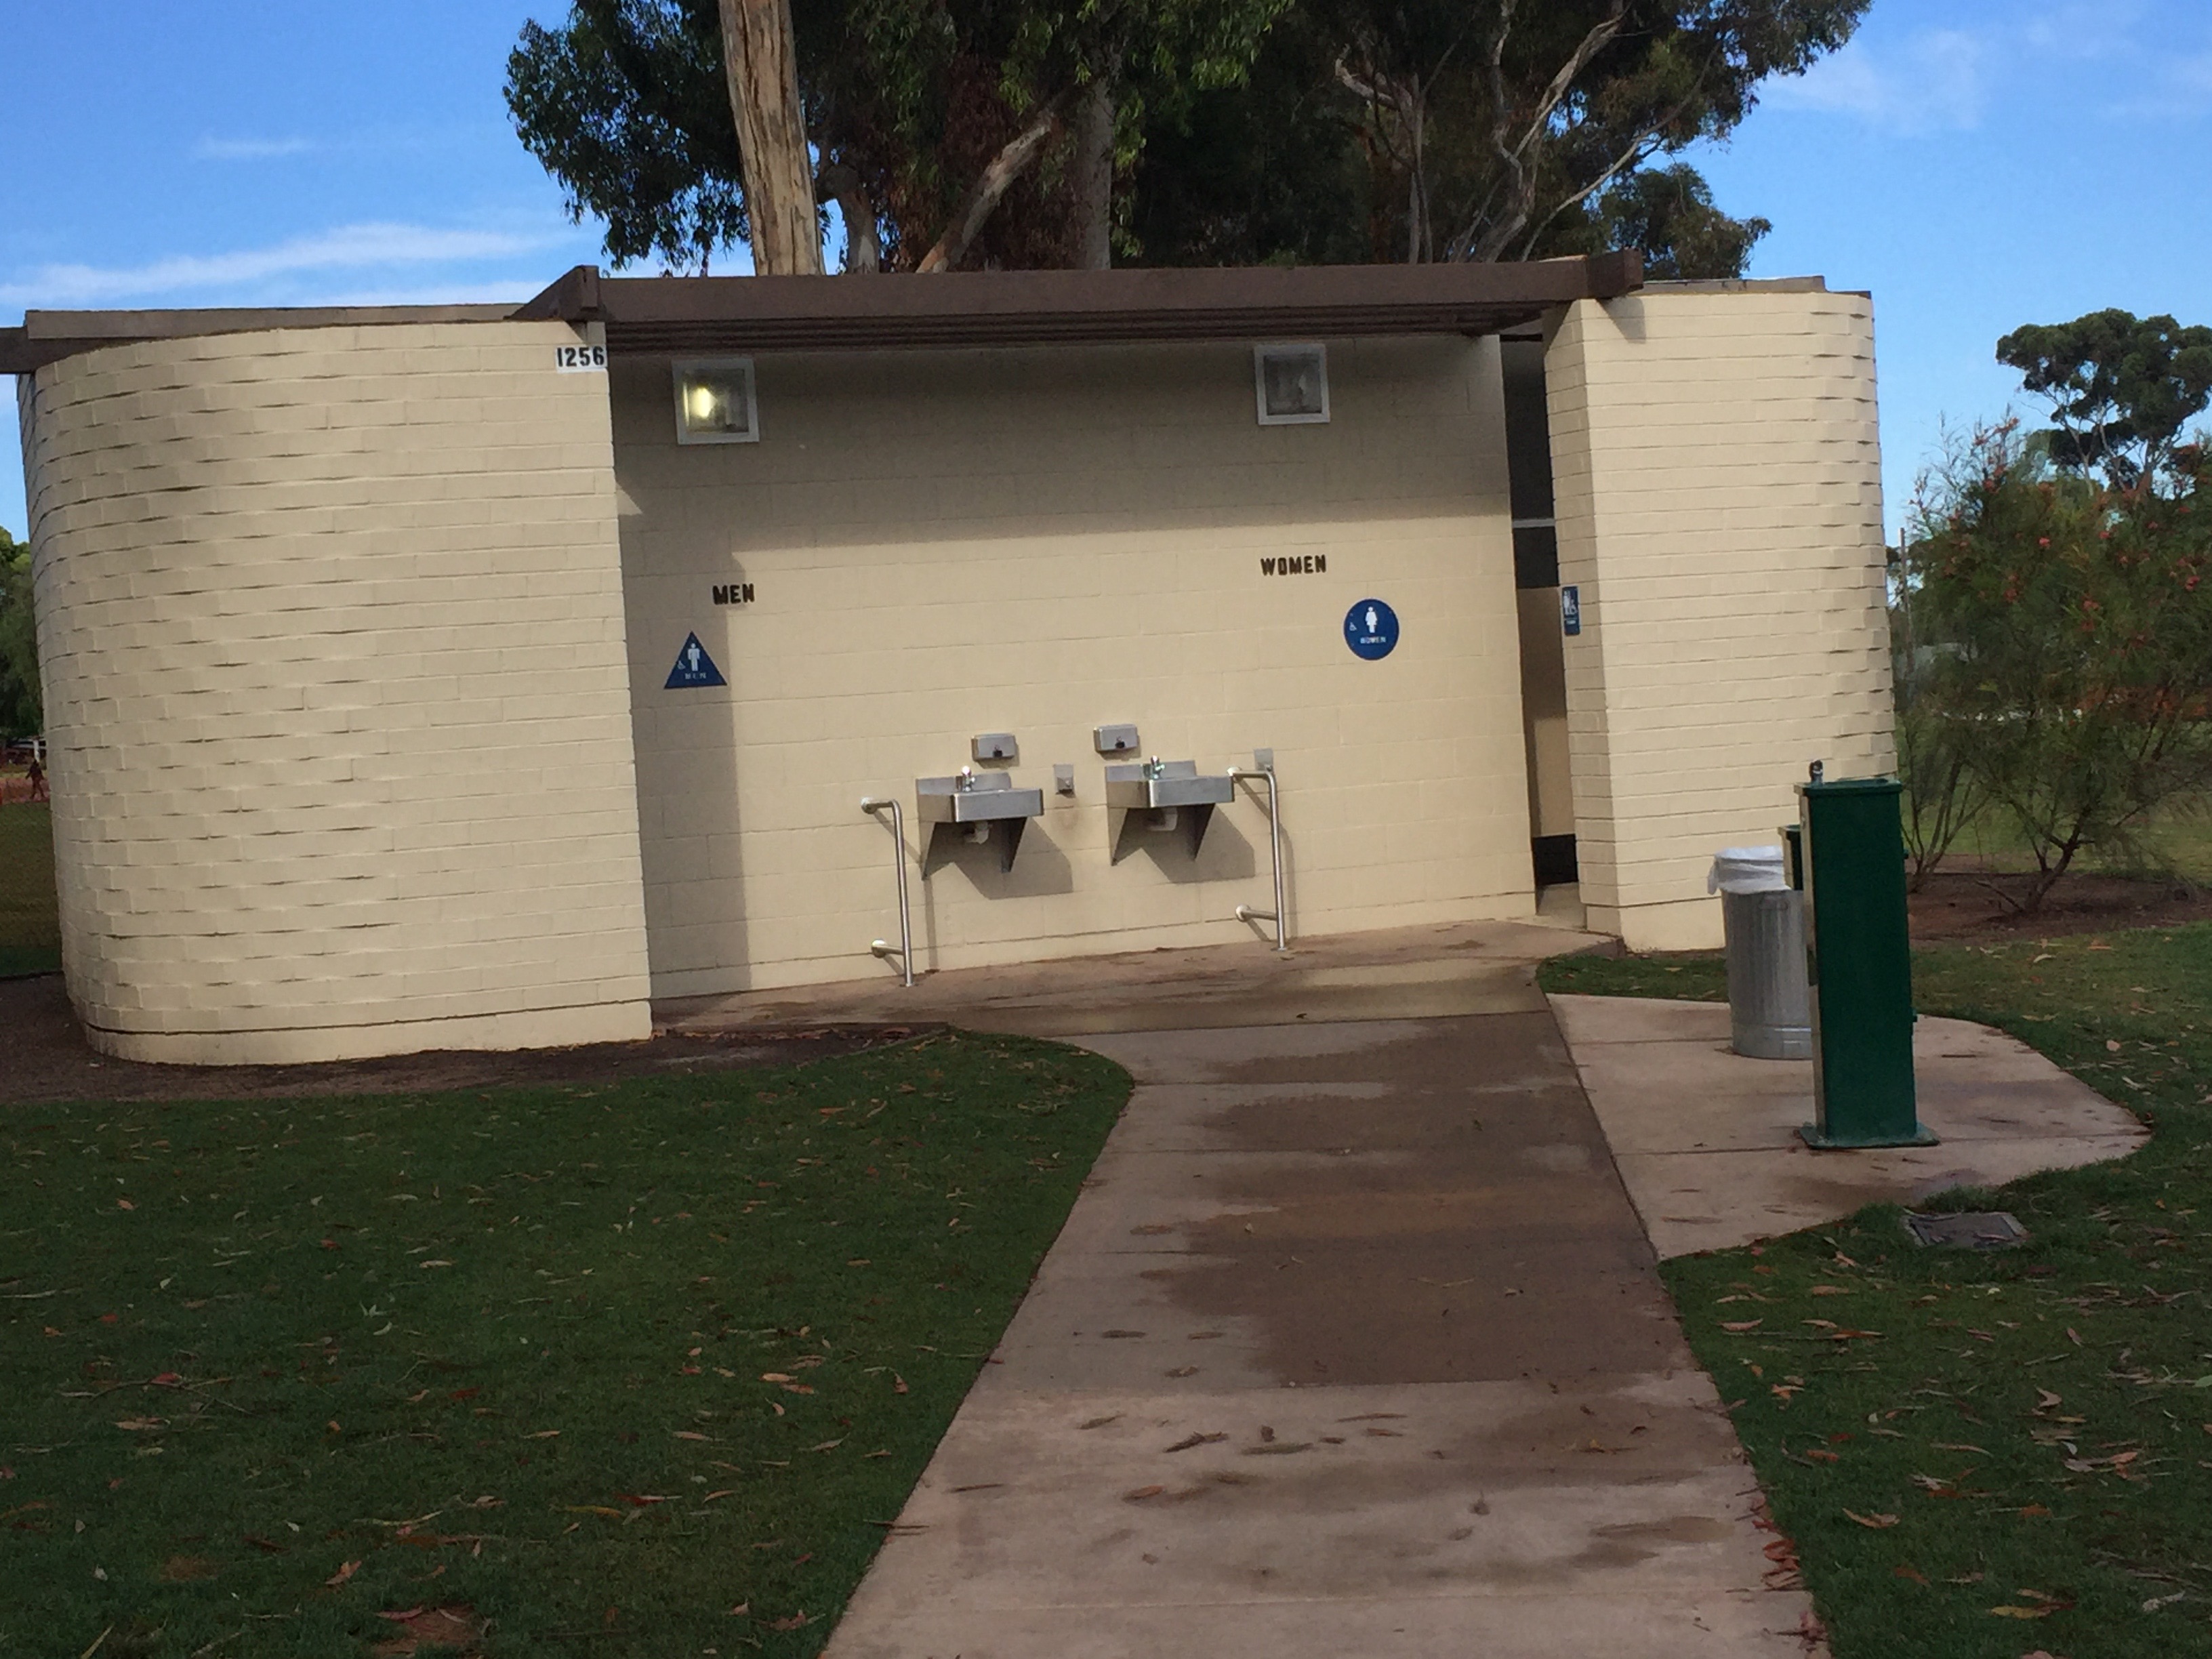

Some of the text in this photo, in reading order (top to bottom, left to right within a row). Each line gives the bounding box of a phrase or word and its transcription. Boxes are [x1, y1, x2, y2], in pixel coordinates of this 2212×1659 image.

[557, 346, 605, 367] 1256
[1260, 554, 1326, 576] WOMEN
[713, 583, 755, 605] MEN
